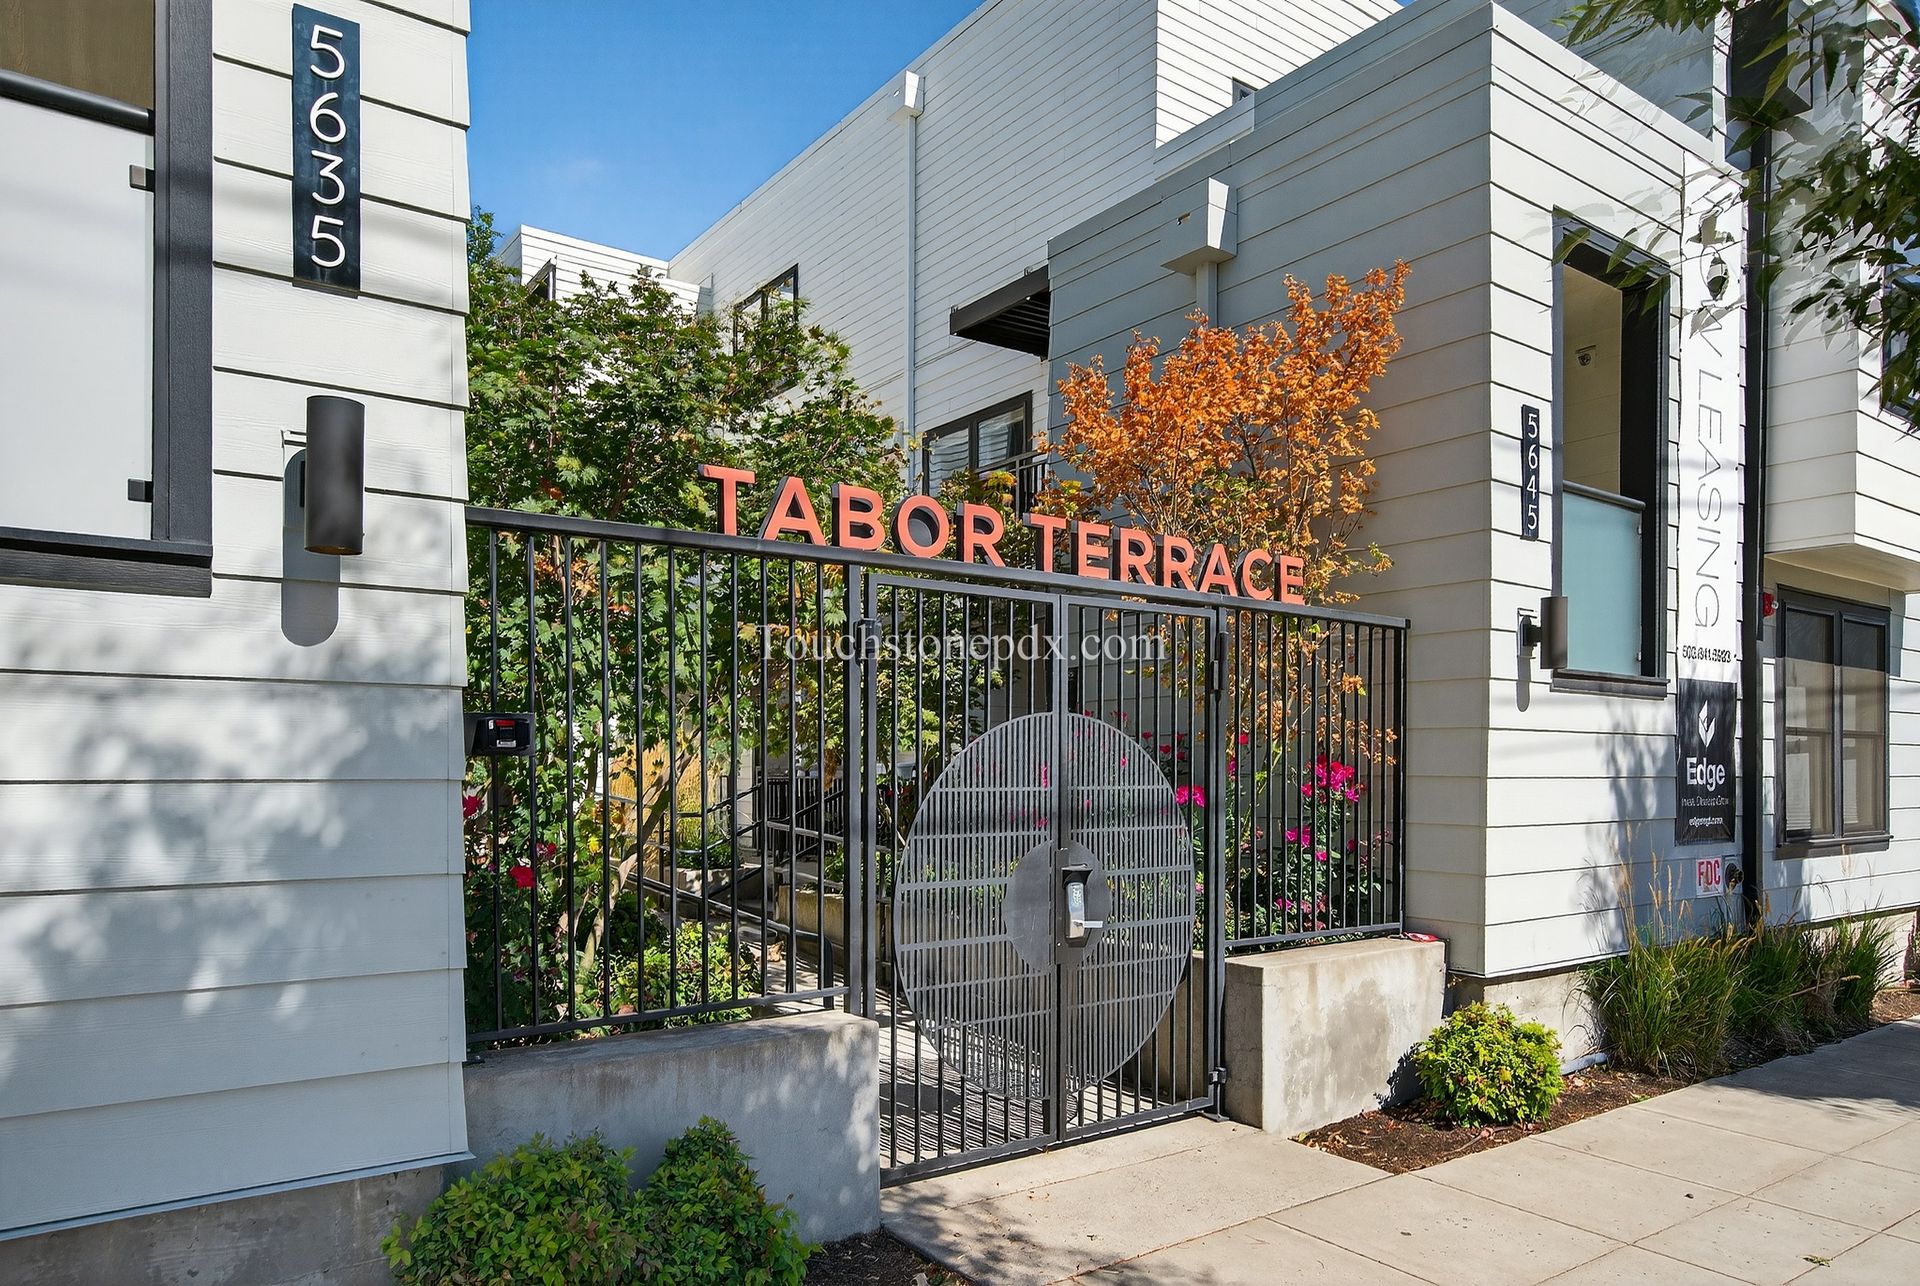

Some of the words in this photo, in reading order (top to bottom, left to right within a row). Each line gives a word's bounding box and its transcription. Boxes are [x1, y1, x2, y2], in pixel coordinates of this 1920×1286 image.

[309, 24, 346, 268] 5635
[1699, 195, 1726, 358] OW
[701, 464, 1005, 566] TABOR
[1023, 513, 1304, 605] TERRACE
[1526, 413, 1538, 530] 5645
[1694, 368, 1722, 629] LEASING
[1686, 757, 1726, 791] Edge
[1698, 860, 1720, 886] FDC
